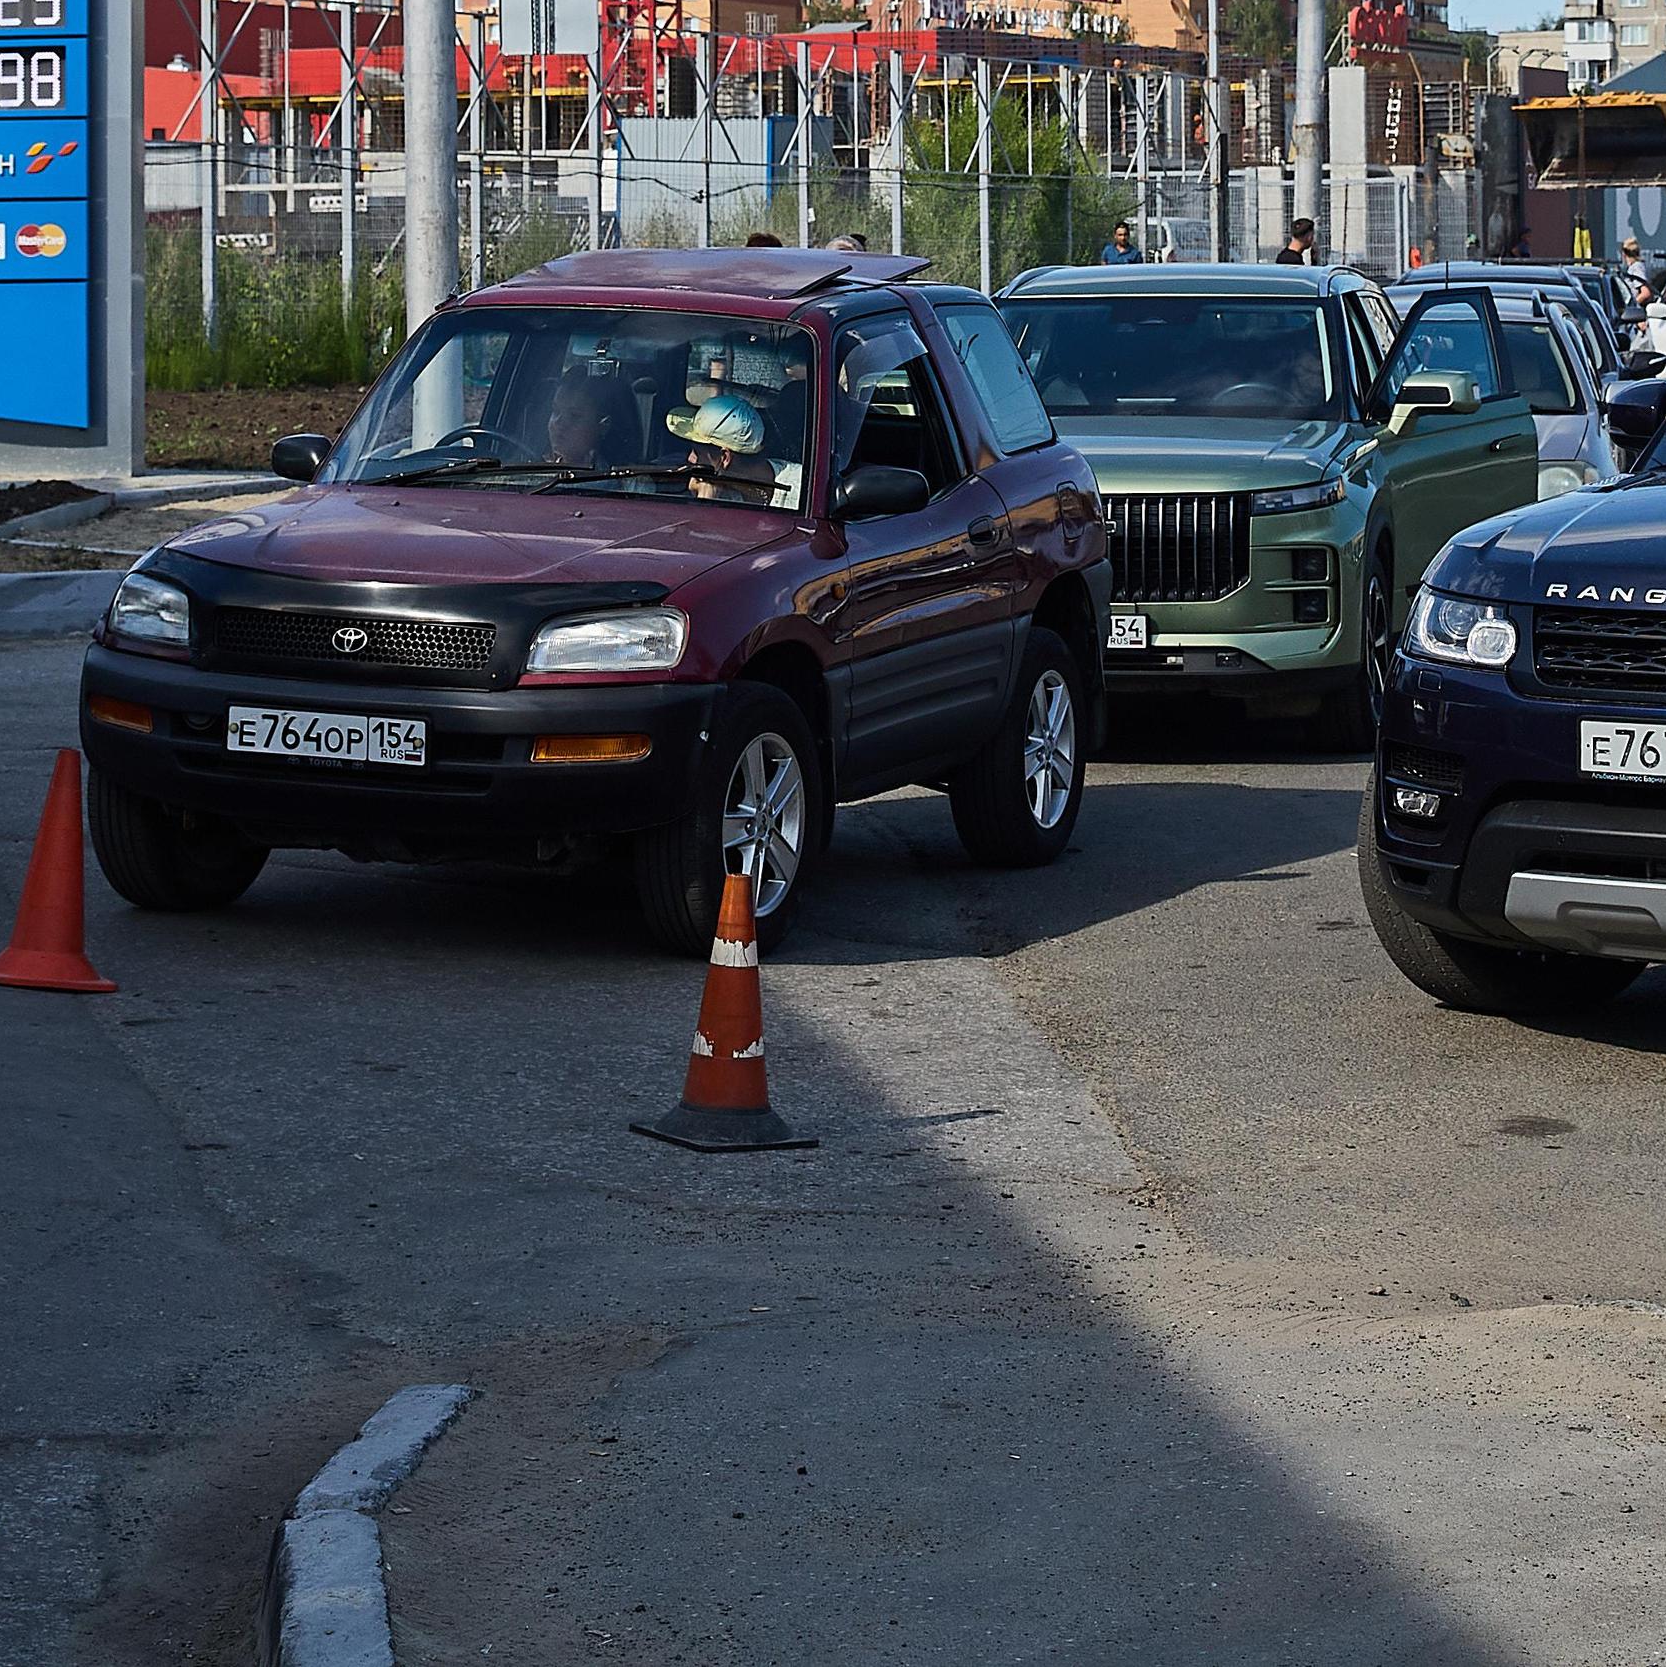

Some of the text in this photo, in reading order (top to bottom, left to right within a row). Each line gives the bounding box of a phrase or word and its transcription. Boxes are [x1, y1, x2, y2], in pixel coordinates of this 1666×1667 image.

[1111, 618, 1139, 637] 54
[238, 713, 421, 755] Е764ОР 154
[380, 748, 404, 760] RUS
[308, 757, 343, 768] TOYOTA
